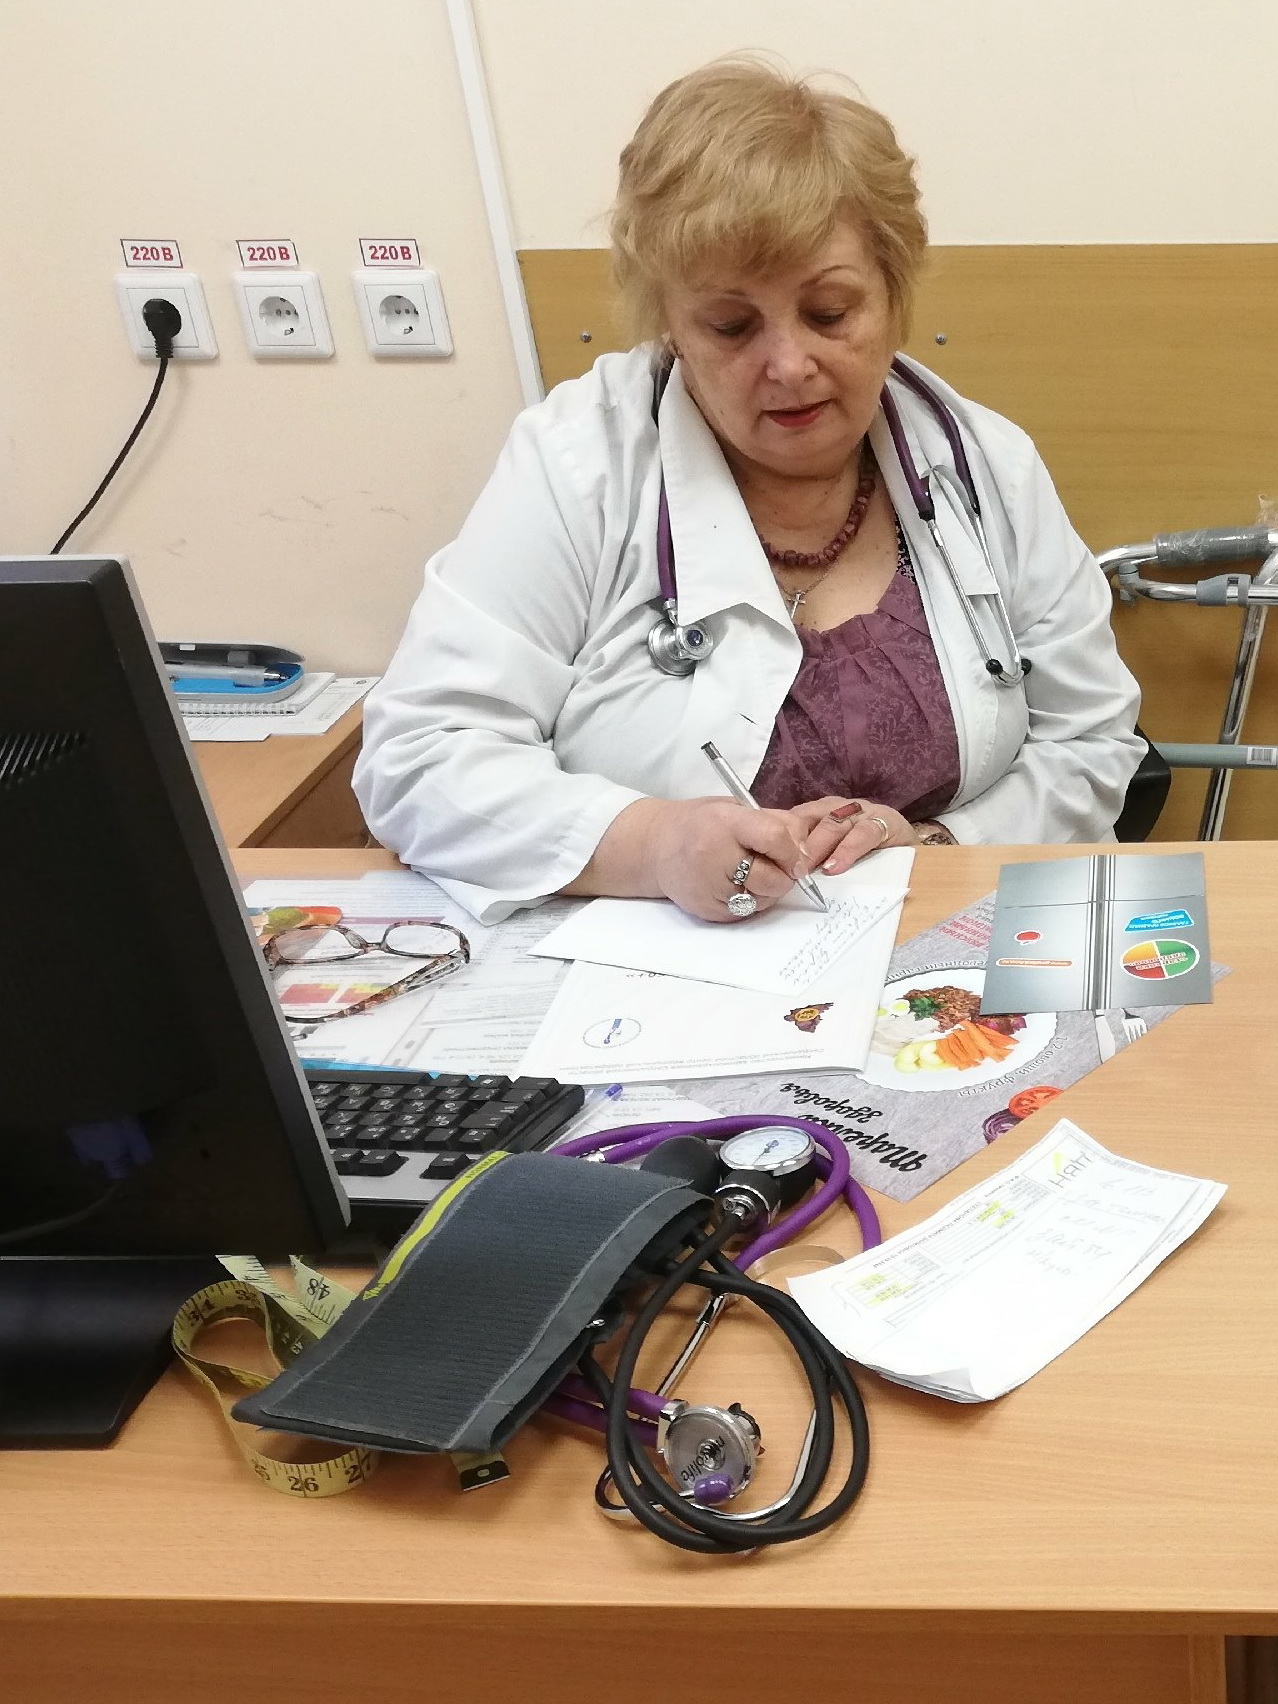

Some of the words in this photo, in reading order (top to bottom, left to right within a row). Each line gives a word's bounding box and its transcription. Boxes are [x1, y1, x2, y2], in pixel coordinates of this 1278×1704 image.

[957, 1073, 1015, 1098] фрукты
[779, 1083, 884, 1124] здоровья
[306, 1278, 331, 1301] 48
[288, 1475, 320, 1492] 26
